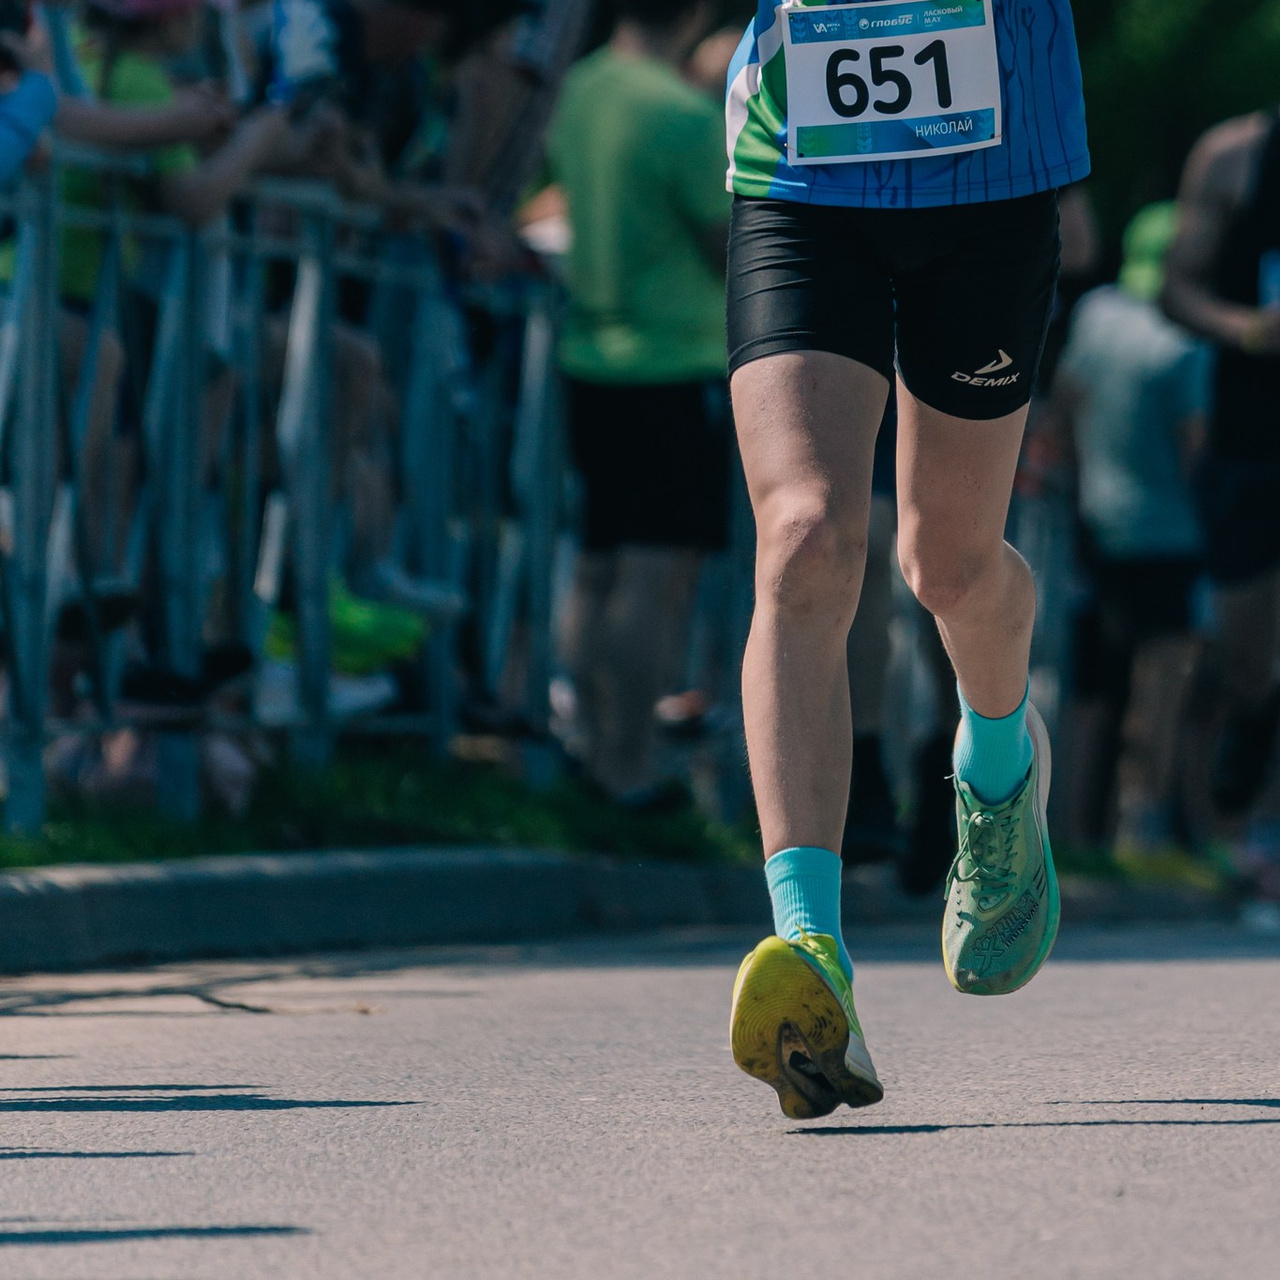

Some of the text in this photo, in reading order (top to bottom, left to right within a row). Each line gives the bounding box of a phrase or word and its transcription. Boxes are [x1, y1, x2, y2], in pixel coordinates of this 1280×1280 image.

[923, 5, 963, 17] ЛАСКОВЫЙ
[870, 15, 913, 28] ГЛОБУС
[826, 39, 952, 118] 651
[915, 116, 973, 138] НИКОЛАЙ
[950, 371, 1020, 387] DEMIX
